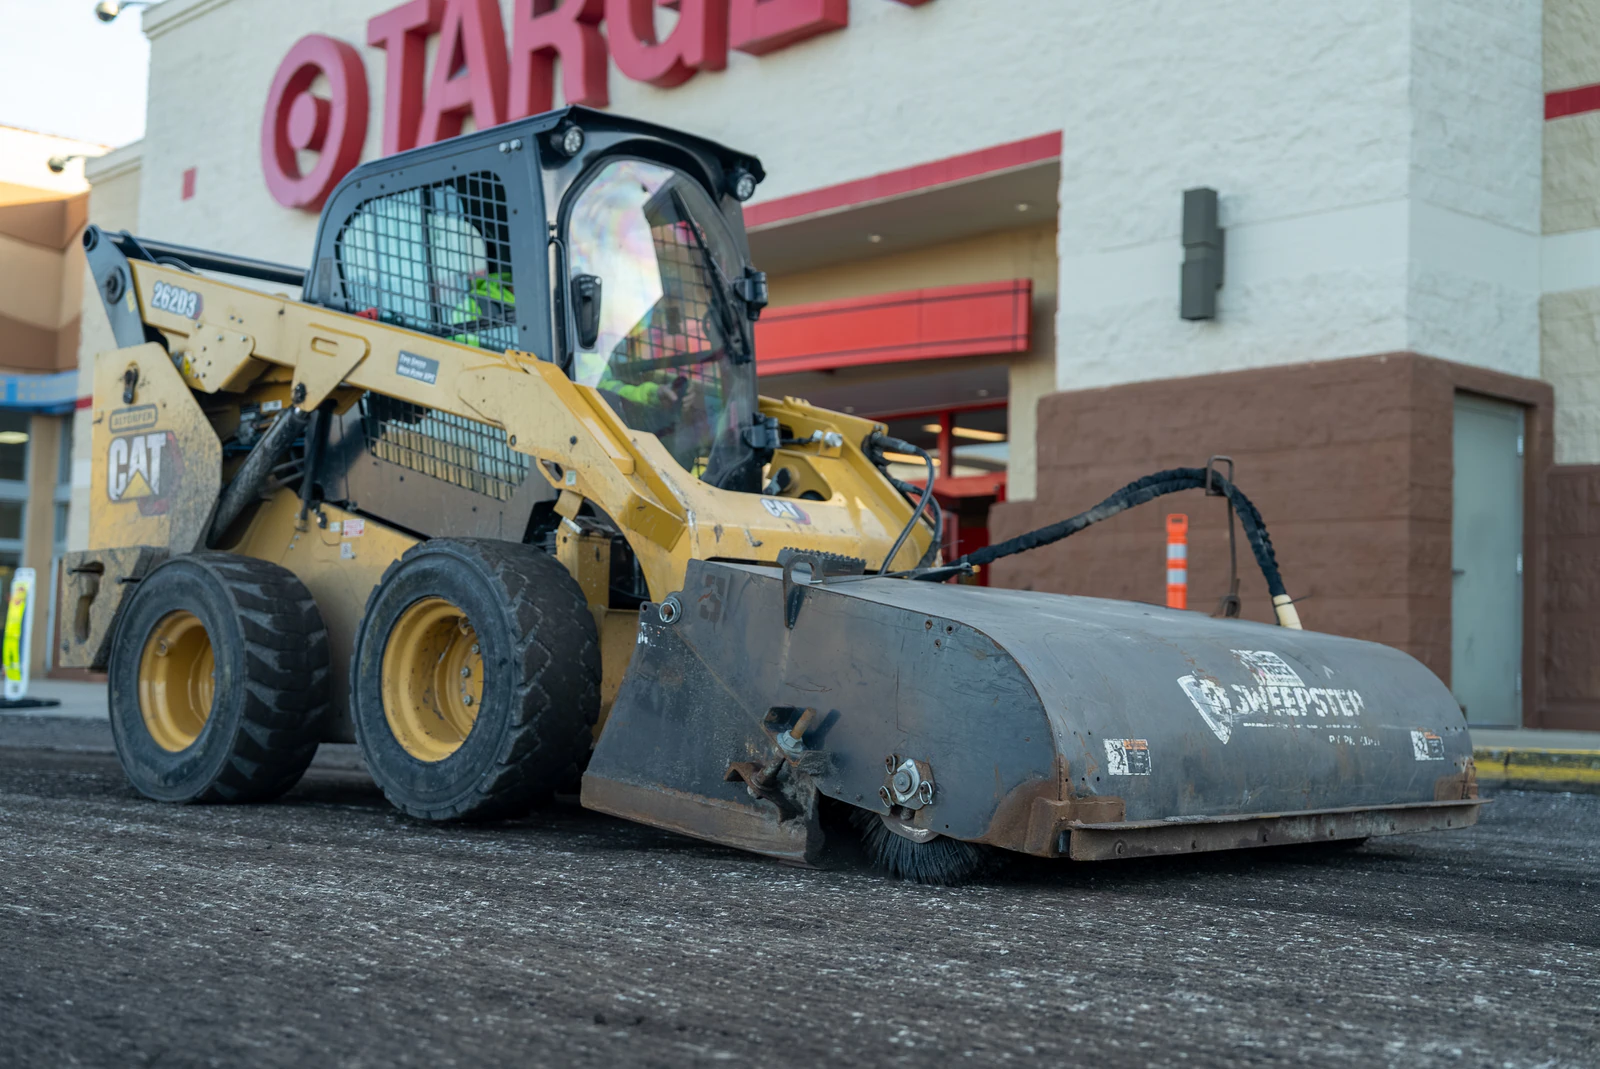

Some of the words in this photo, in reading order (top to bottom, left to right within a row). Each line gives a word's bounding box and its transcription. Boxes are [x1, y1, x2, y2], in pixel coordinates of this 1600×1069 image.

[152, 280, 198, 318] 262D3
[109, 432, 166, 500] CAT
[760, 498, 801, 519] CAT
